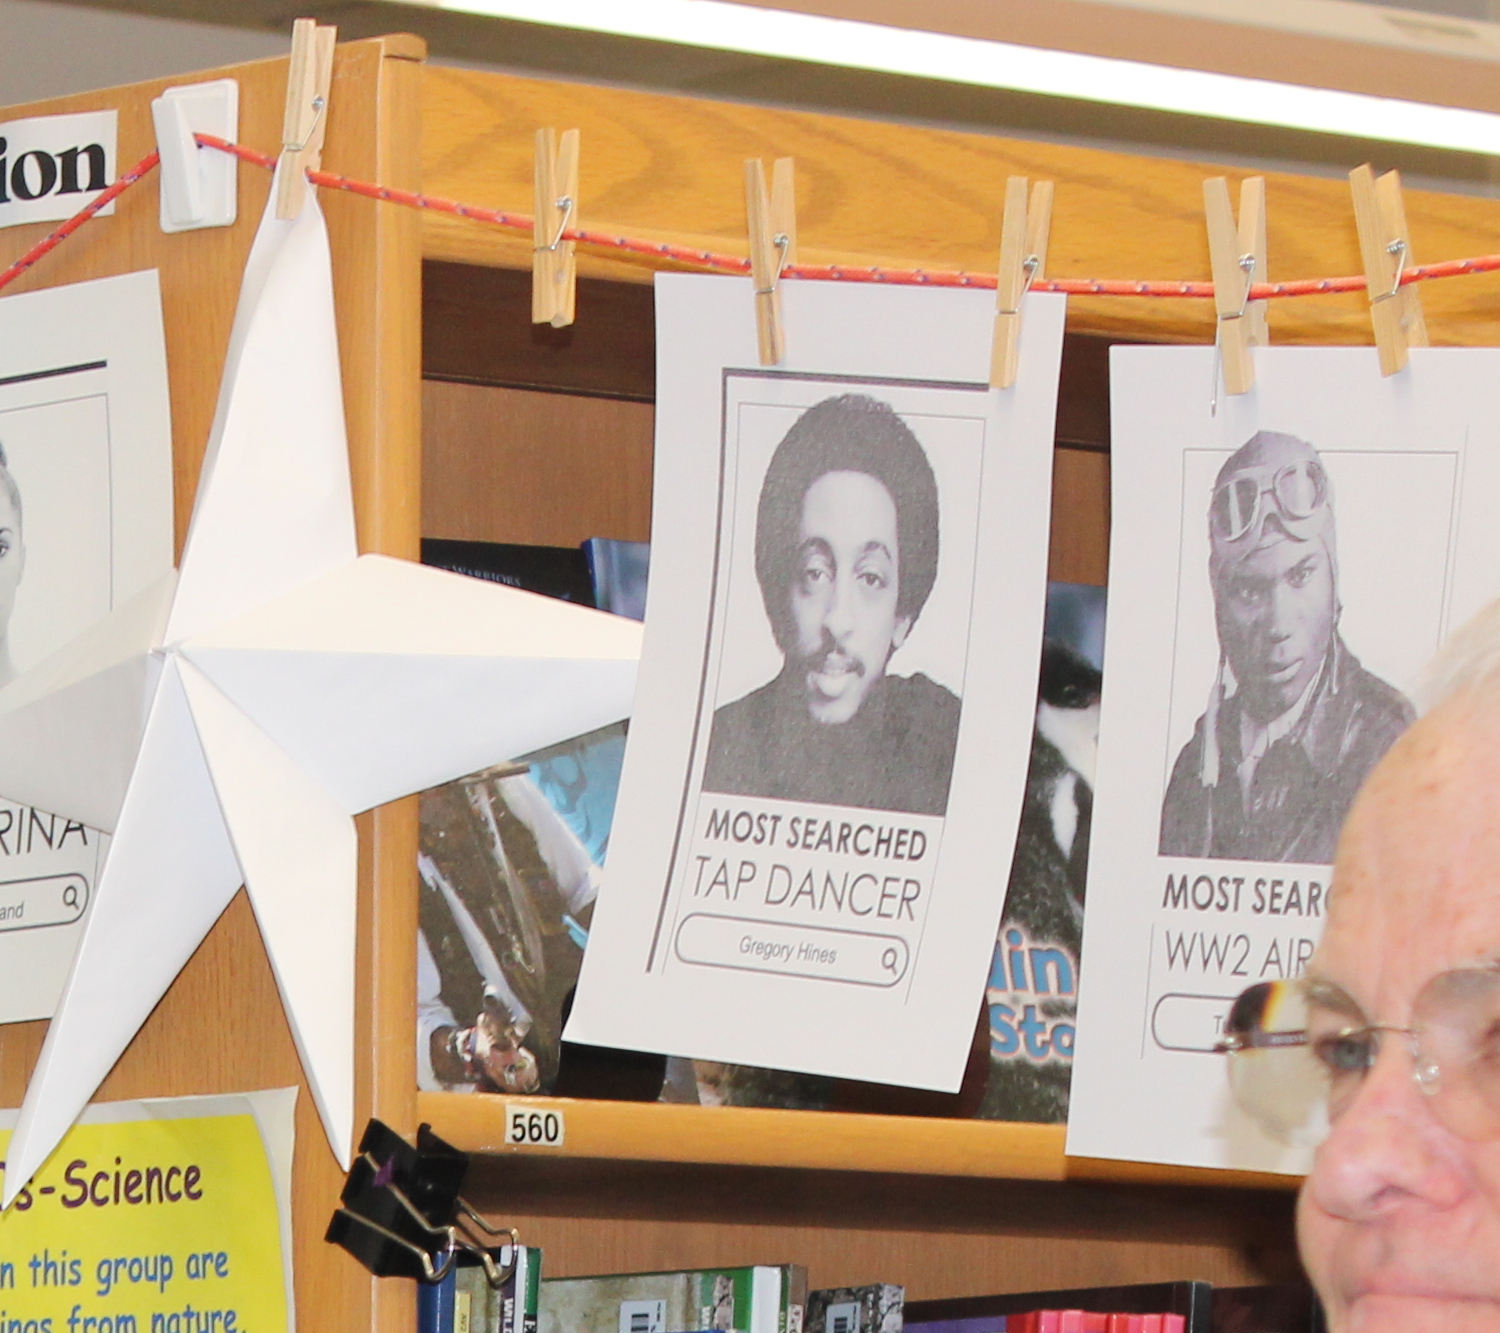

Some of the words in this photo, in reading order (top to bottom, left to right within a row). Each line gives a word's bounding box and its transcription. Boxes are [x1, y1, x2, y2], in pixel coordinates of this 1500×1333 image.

[704, 808, 782, 846] MOST
[786, 816, 927, 862] SEARCHED
[694, 855, 759, 900] TAP
[764, 864, 921, 922] DANCER
[1161, 873, 1246, 912] MOST
[738, 934, 795, 965] Gregory
[797, 941, 837, 966] Hines
[1165, 929, 1251, 978] WW2
[511, 1114, 560, 1143] 560
[27, 1250, 83, 1289] this
[96, 1250, 174, 1297] group
[184, 1247, 230, 1280] are
